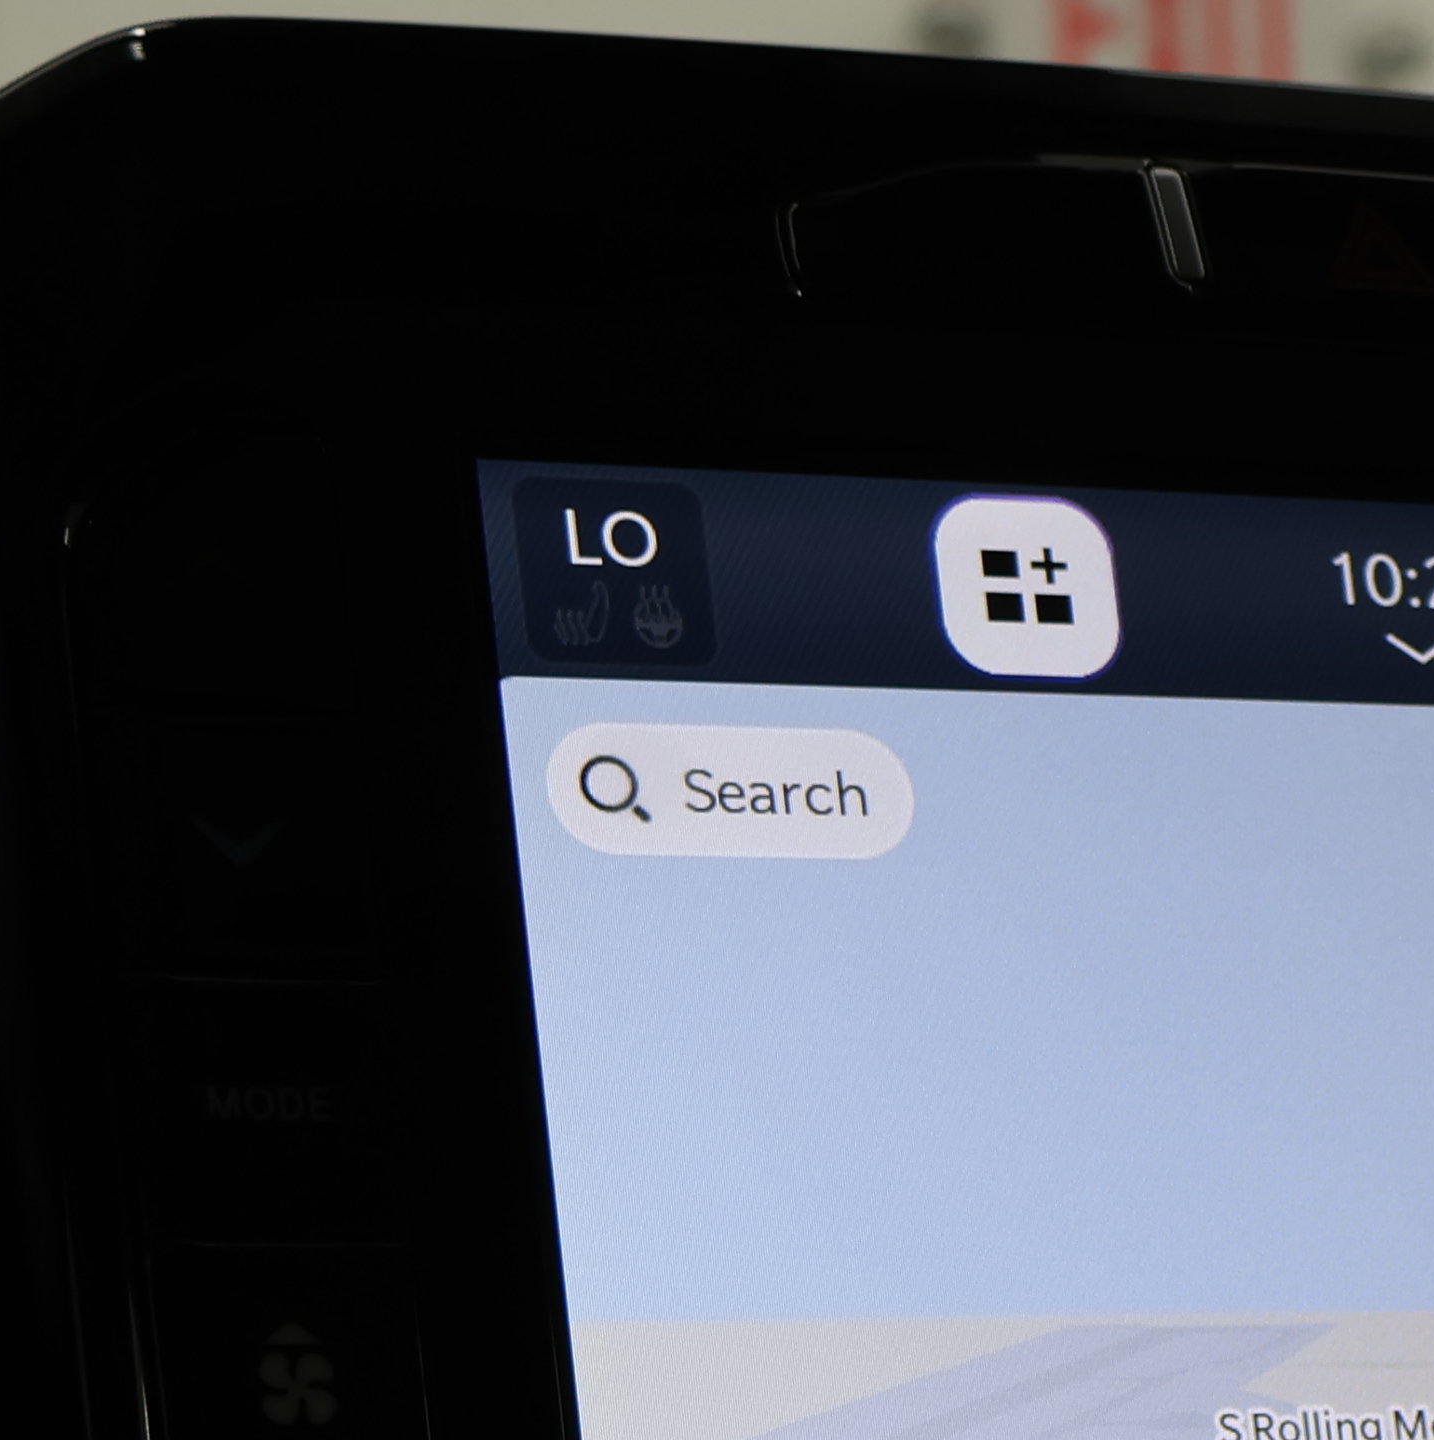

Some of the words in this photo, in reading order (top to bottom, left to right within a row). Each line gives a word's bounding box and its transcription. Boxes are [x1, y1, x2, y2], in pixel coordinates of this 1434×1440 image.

[565, 508, 657, 567] LO
[684, 769, 868, 817] Search
[206, 1084, 330, 1121] MODE
